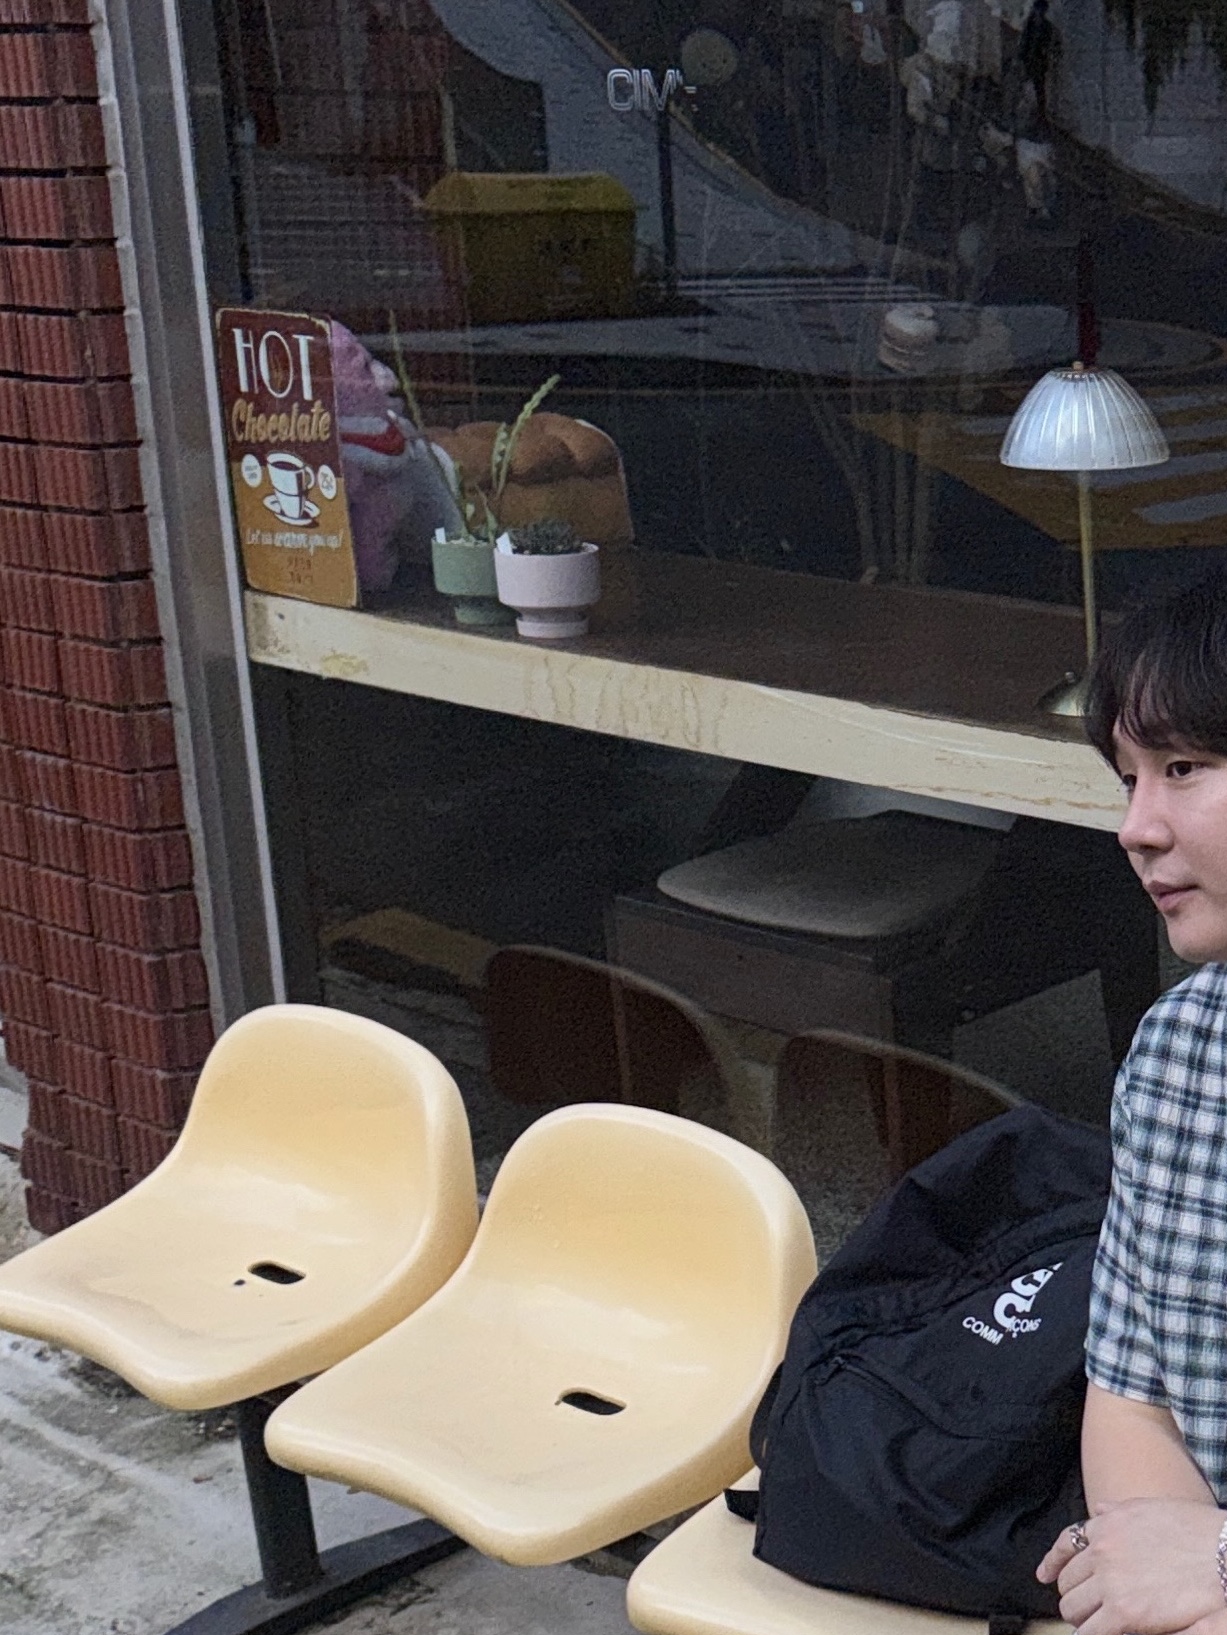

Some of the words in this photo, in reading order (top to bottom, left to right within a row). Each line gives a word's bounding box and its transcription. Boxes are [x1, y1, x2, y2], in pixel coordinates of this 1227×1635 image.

[231, 328, 314, 401] HOT
[231, 398, 332, 444] Chocolate
[962, 1316, 1004, 1346] COMM
